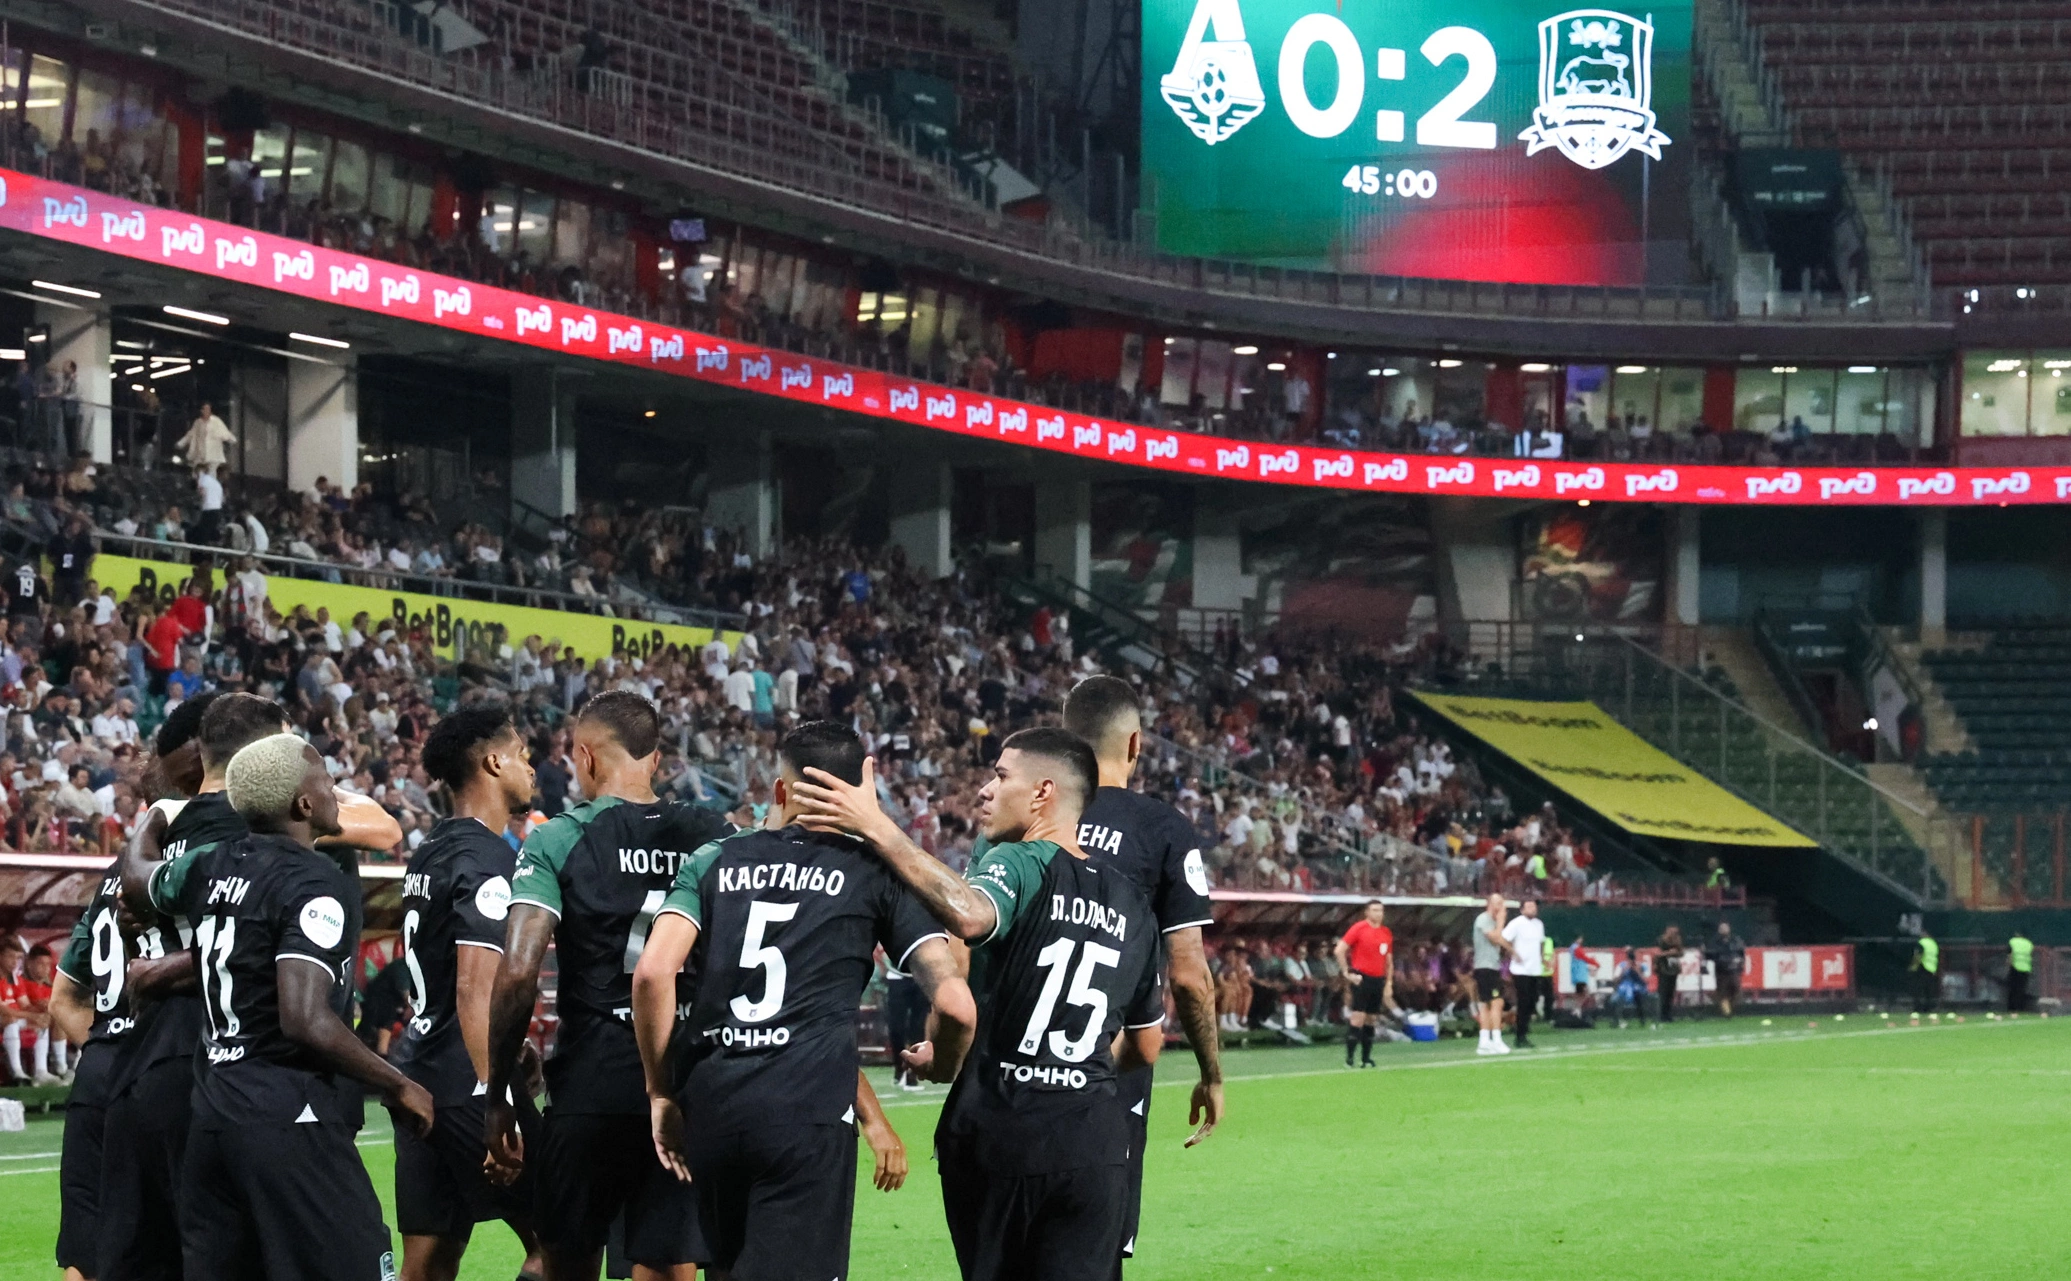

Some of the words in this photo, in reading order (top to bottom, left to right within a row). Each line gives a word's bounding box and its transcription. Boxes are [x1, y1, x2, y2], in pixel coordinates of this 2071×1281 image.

[1278, 13, 1498, 149] 0:2
[1342, 164, 1438, 199] 45:00
[1075, 823, 1123, 855] ЕНА
[718, 862, 845, 896] КАСТАНЬО
[729, 900, 799, 1023] 5
[1017, 937, 1121, 1063] 15
